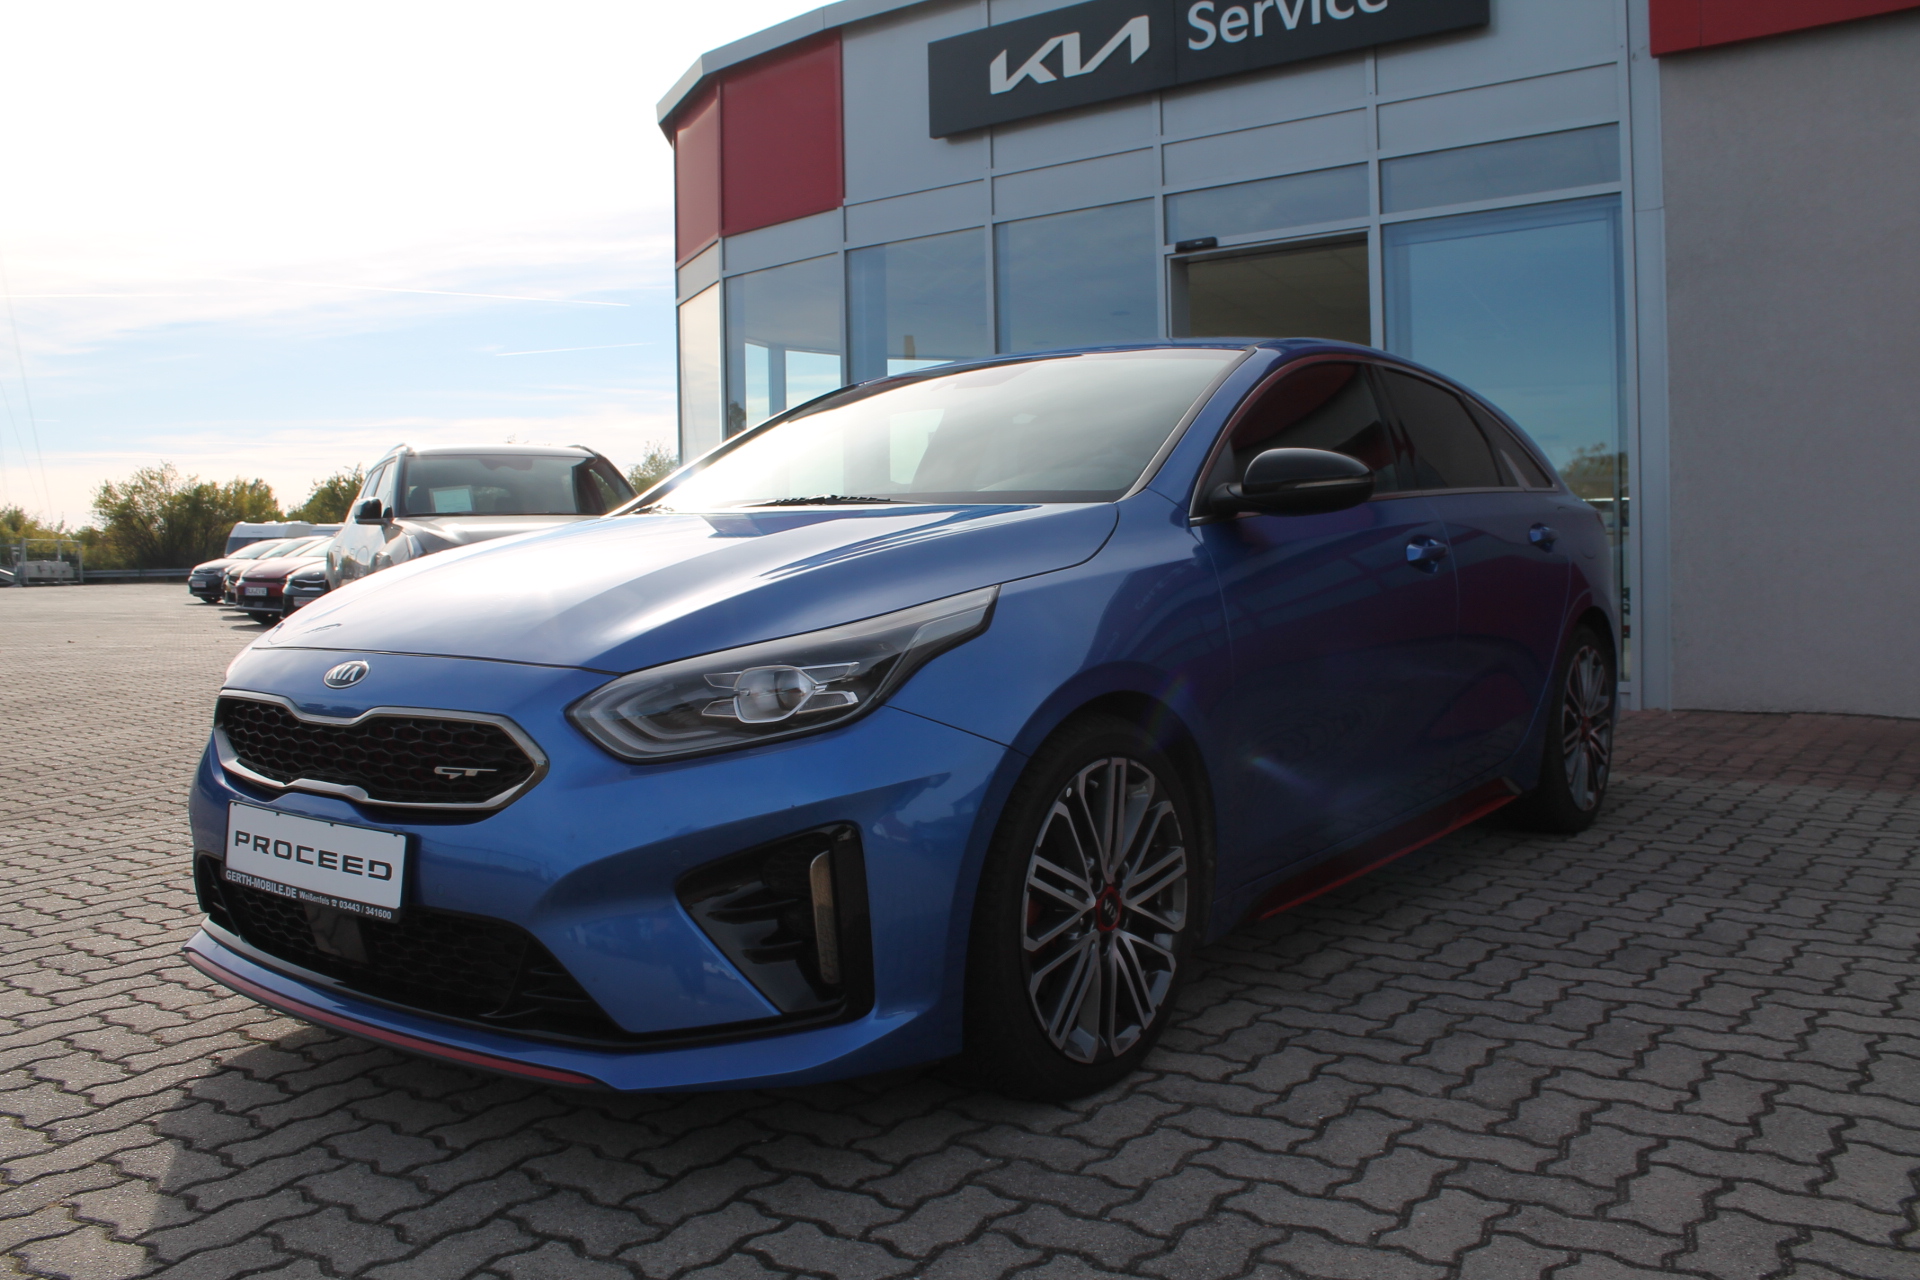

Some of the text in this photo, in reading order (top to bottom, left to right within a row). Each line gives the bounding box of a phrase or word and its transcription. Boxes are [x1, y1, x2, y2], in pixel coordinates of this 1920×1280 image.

[327, 664, 361, 682] KIA
[434, 766, 497, 779] GT
[235, 830, 393, 881] PROCEED
[226, 870, 297, 898] GERTH-MOBILE.DE
[339, 900, 360, 912] 03443
[365, 906, 392, 920] 341600
